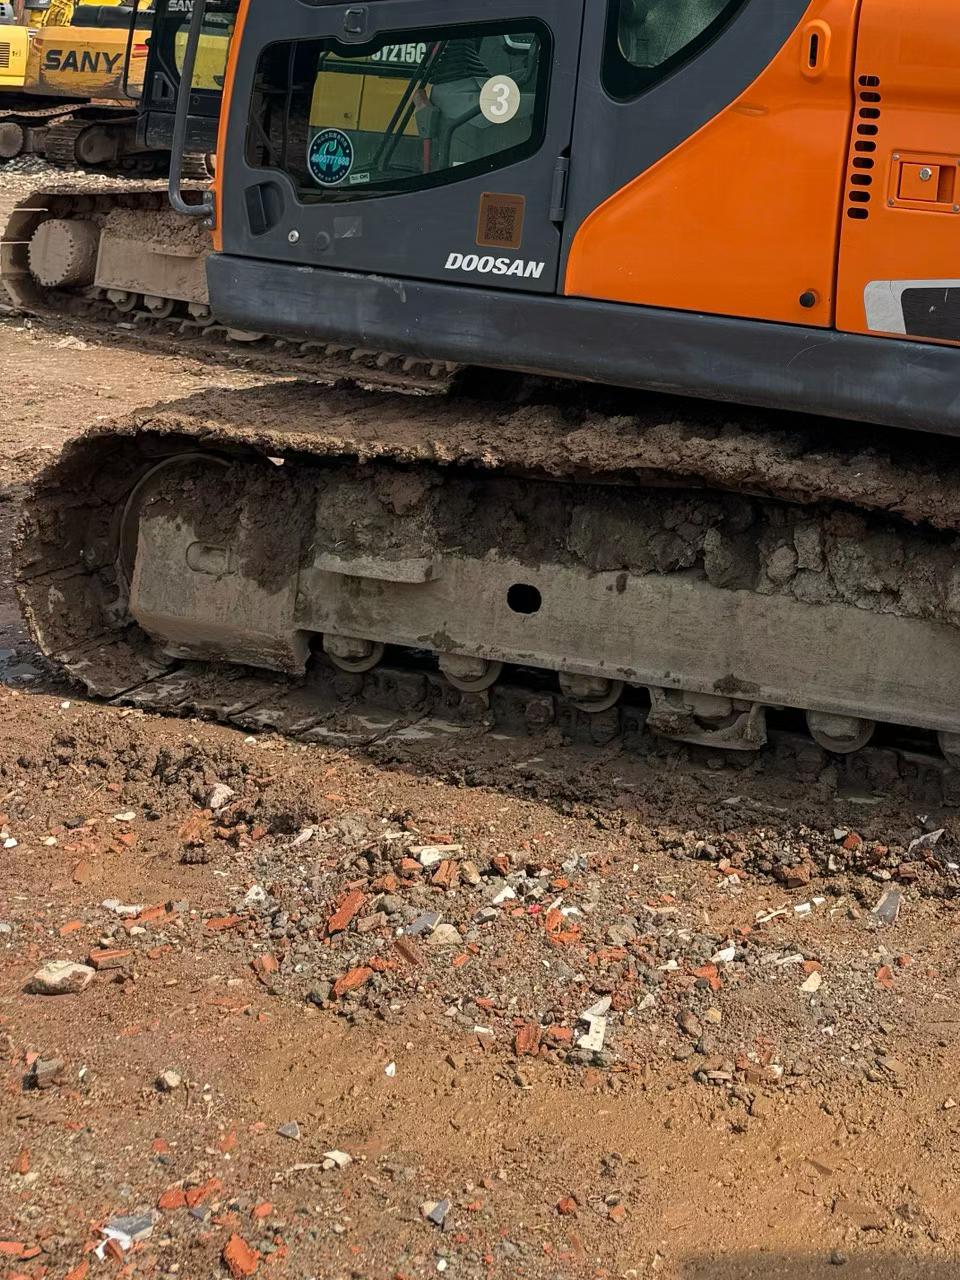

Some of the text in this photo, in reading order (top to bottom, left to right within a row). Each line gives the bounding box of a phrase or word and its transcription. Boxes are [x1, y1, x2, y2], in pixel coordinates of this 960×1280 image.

[168, 0, 195, 12] SAN
[45, 49, 123, 74] SANY
[490, 82, 511, 116] 3
[444, 252, 546, 280] DOOSAN
